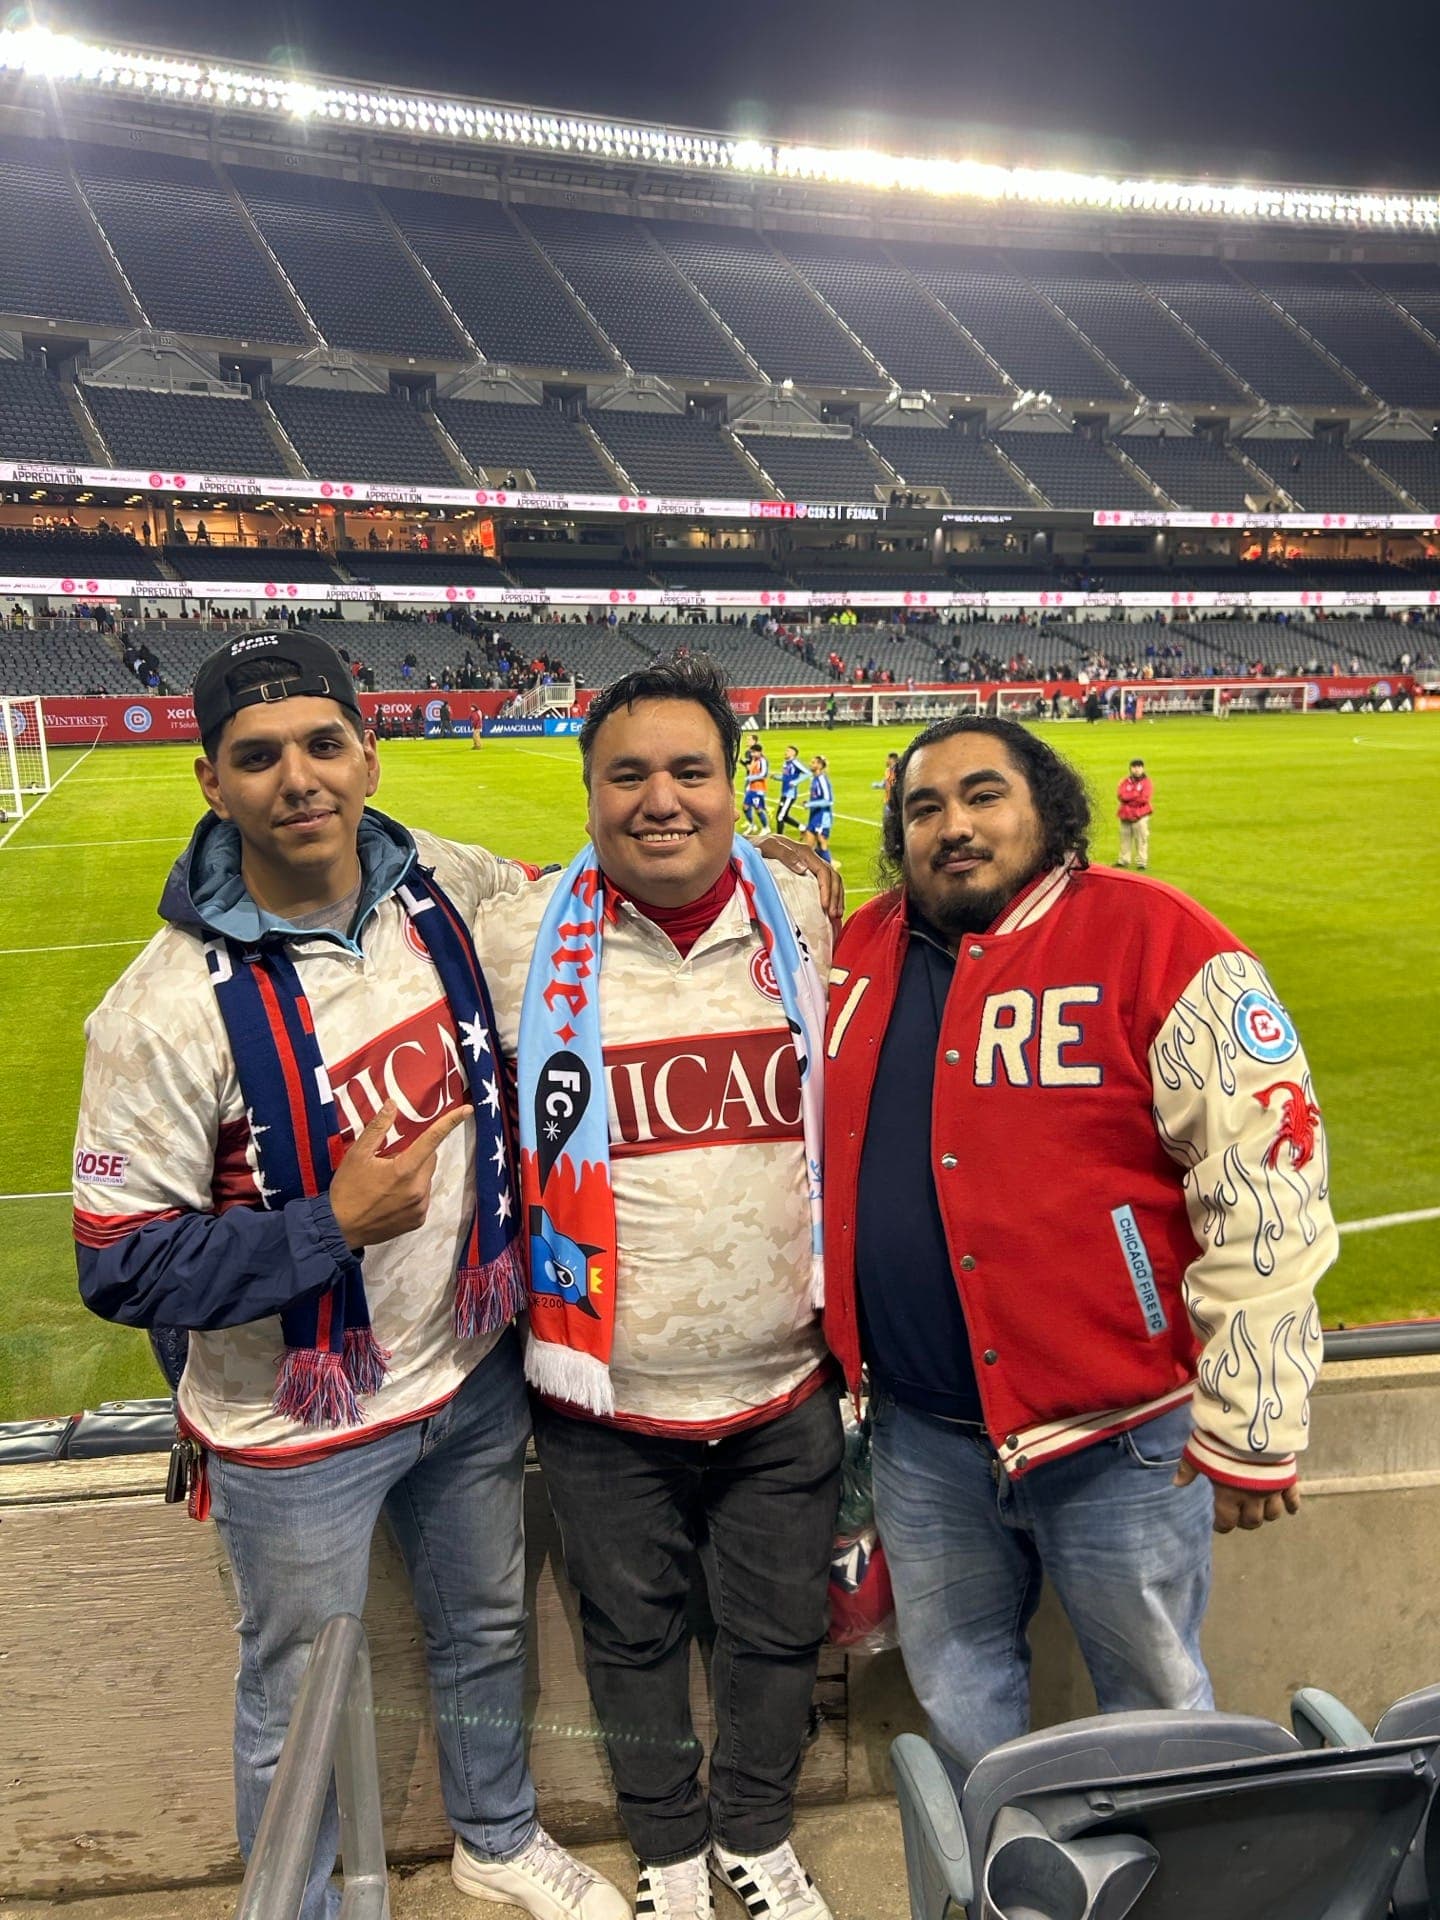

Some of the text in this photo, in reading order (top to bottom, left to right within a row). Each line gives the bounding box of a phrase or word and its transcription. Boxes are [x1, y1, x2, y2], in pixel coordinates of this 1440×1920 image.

[12, 470, 83, 484] APPRECIATION
[199, 481, 262, 495] APPRECIATION
[365, 489, 422, 503] APPRECIATION
[516, 498, 569, 510] APPRECIATION
[762, 507, 781, 518] CHI
[807, 507, 827, 519] CIN
[846, 508, 879, 520] FINAL
[130, 586, 193, 597] APPRECIATION
[326, 589, 382, 600] APPRECIATION
[500, 593, 551, 604] APPRECIATION
[43, 714, 106, 726] WINTRUST
[503, 724, 543, 733] MAGELLAN
[974, 985, 1102, 1088] RE
[545, 1069, 581, 1118] FC
[1119, 1217, 1163, 1330] CHICAGO FIRE FC
[541, 1296, 565, 1309] 200
